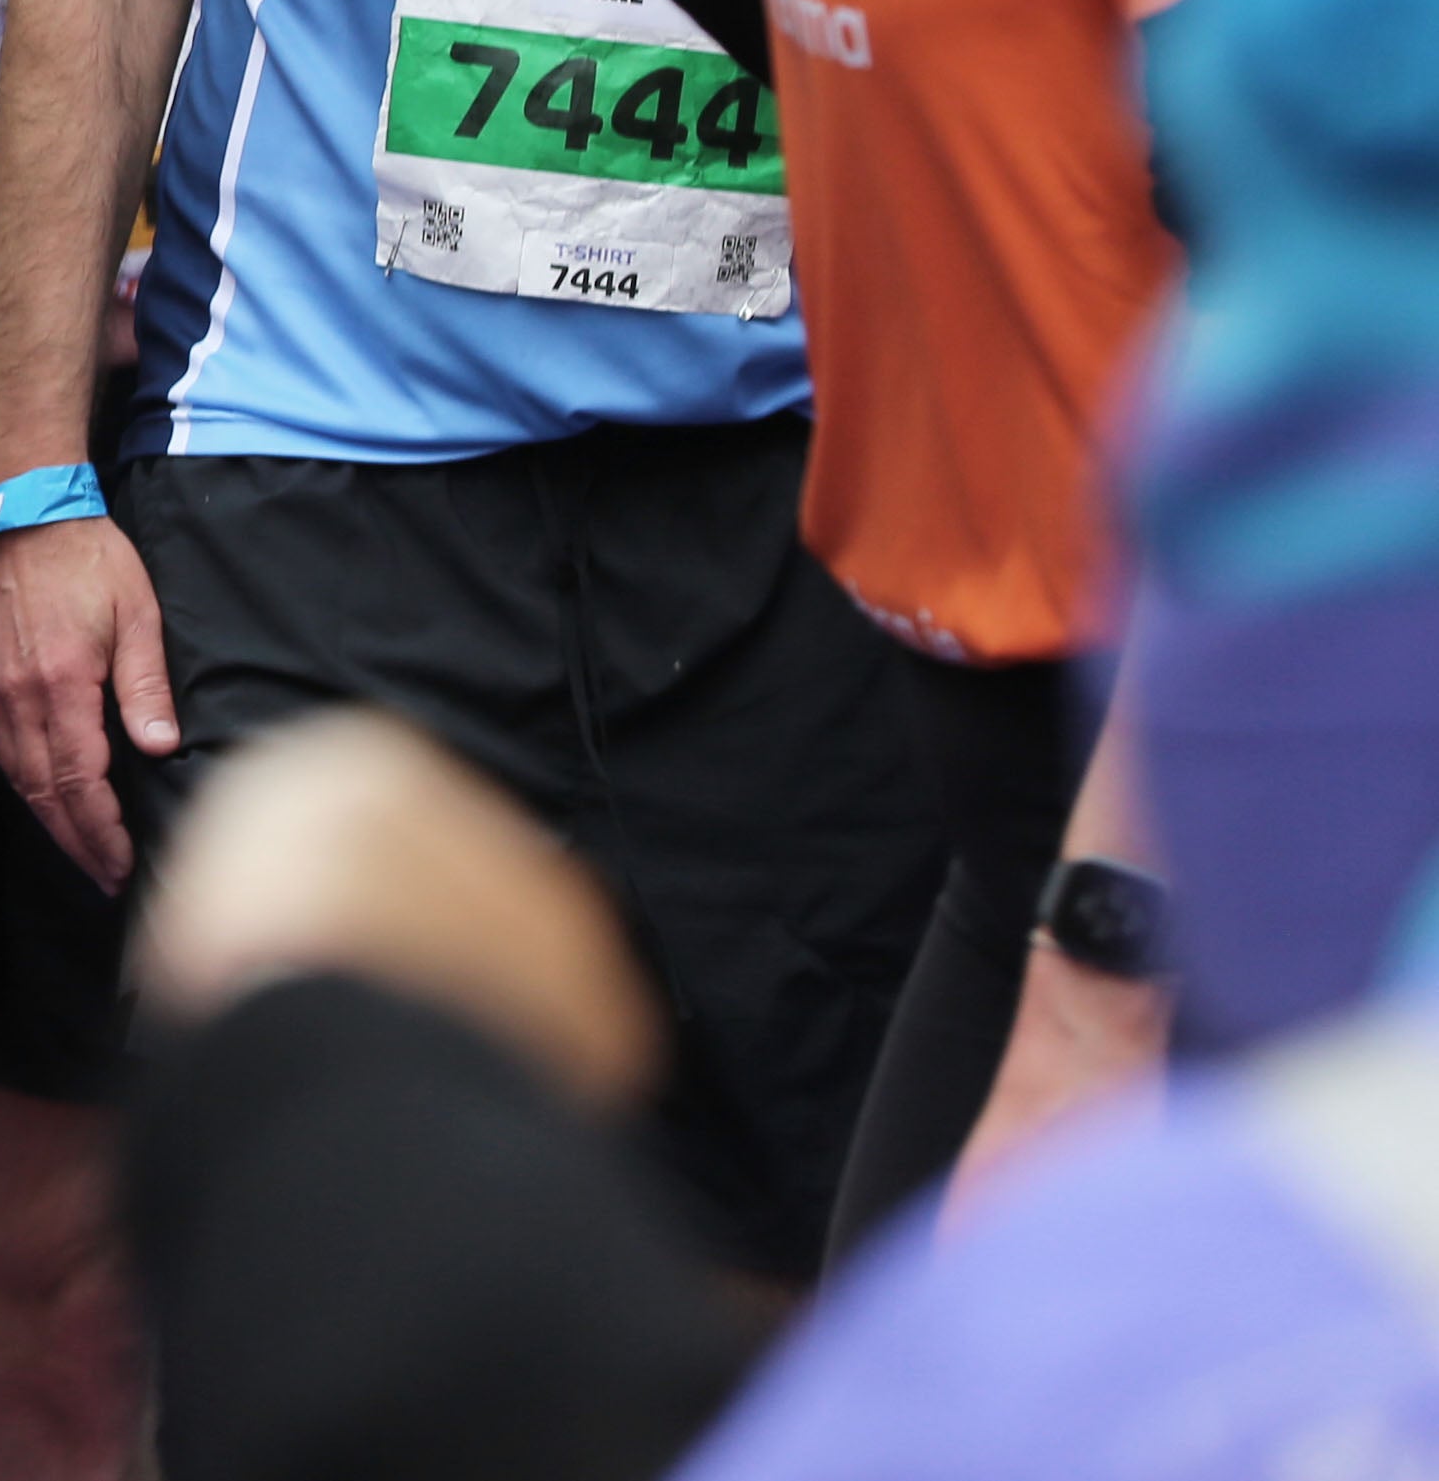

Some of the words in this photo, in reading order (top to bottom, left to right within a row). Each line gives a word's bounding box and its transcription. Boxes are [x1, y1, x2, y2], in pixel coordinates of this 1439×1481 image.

[449, 41, 763, 170] 7444
[554, 241, 638, 267] T-SHIRT
[549, 263, 640, 300] 7444
